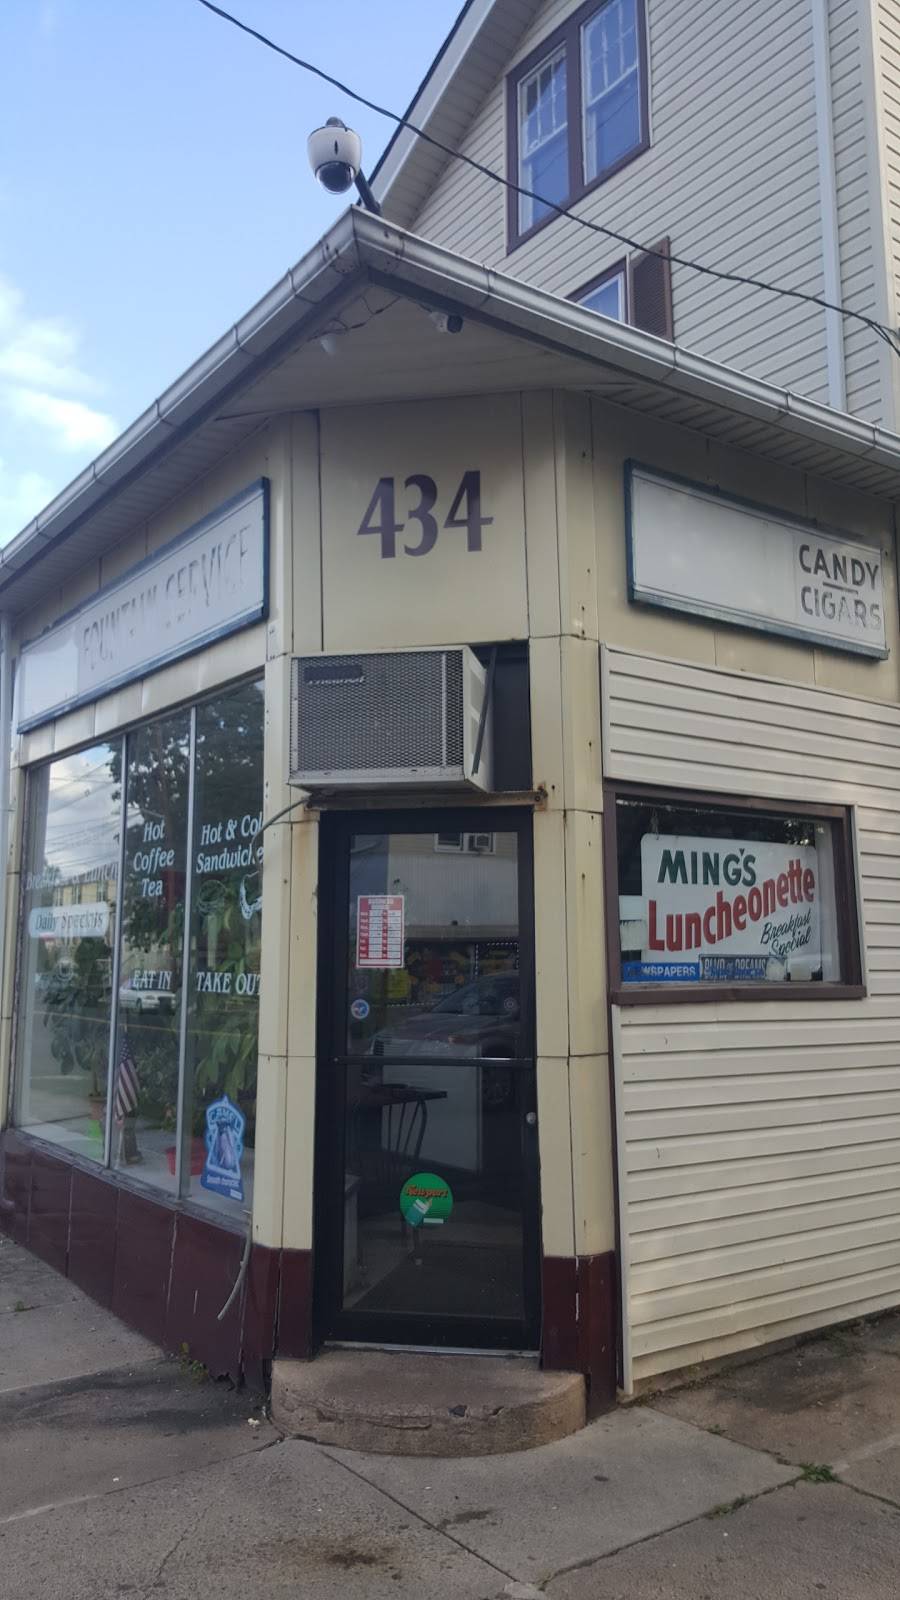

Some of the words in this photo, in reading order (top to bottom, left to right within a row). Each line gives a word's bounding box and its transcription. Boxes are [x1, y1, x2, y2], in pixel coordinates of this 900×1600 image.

[357, 470, 494, 559] 434
[799, 544, 879, 590] CANDY
[801, 586, 882, 632] CIGARS
[143, 818, 165, 843] Hot
[200, 822, 222, 846] Hot
[225, 818, 238, 840] &
[241, 811, 263, 837] Col
[133, 846, 175, 874] Coffee
[196, 844, 264, 874] Sandwiche
[141, 878, 164, 897] Tea
[648, 858, 816, 952] Luncheonette
[760, 906, 811, 945] Breakfast
[771, 926, 811, 957] Special
[132, 970, 156, 990] EAT
[159, 970, 172, 990] IN
[196, 971, 232, 994] TAKE
